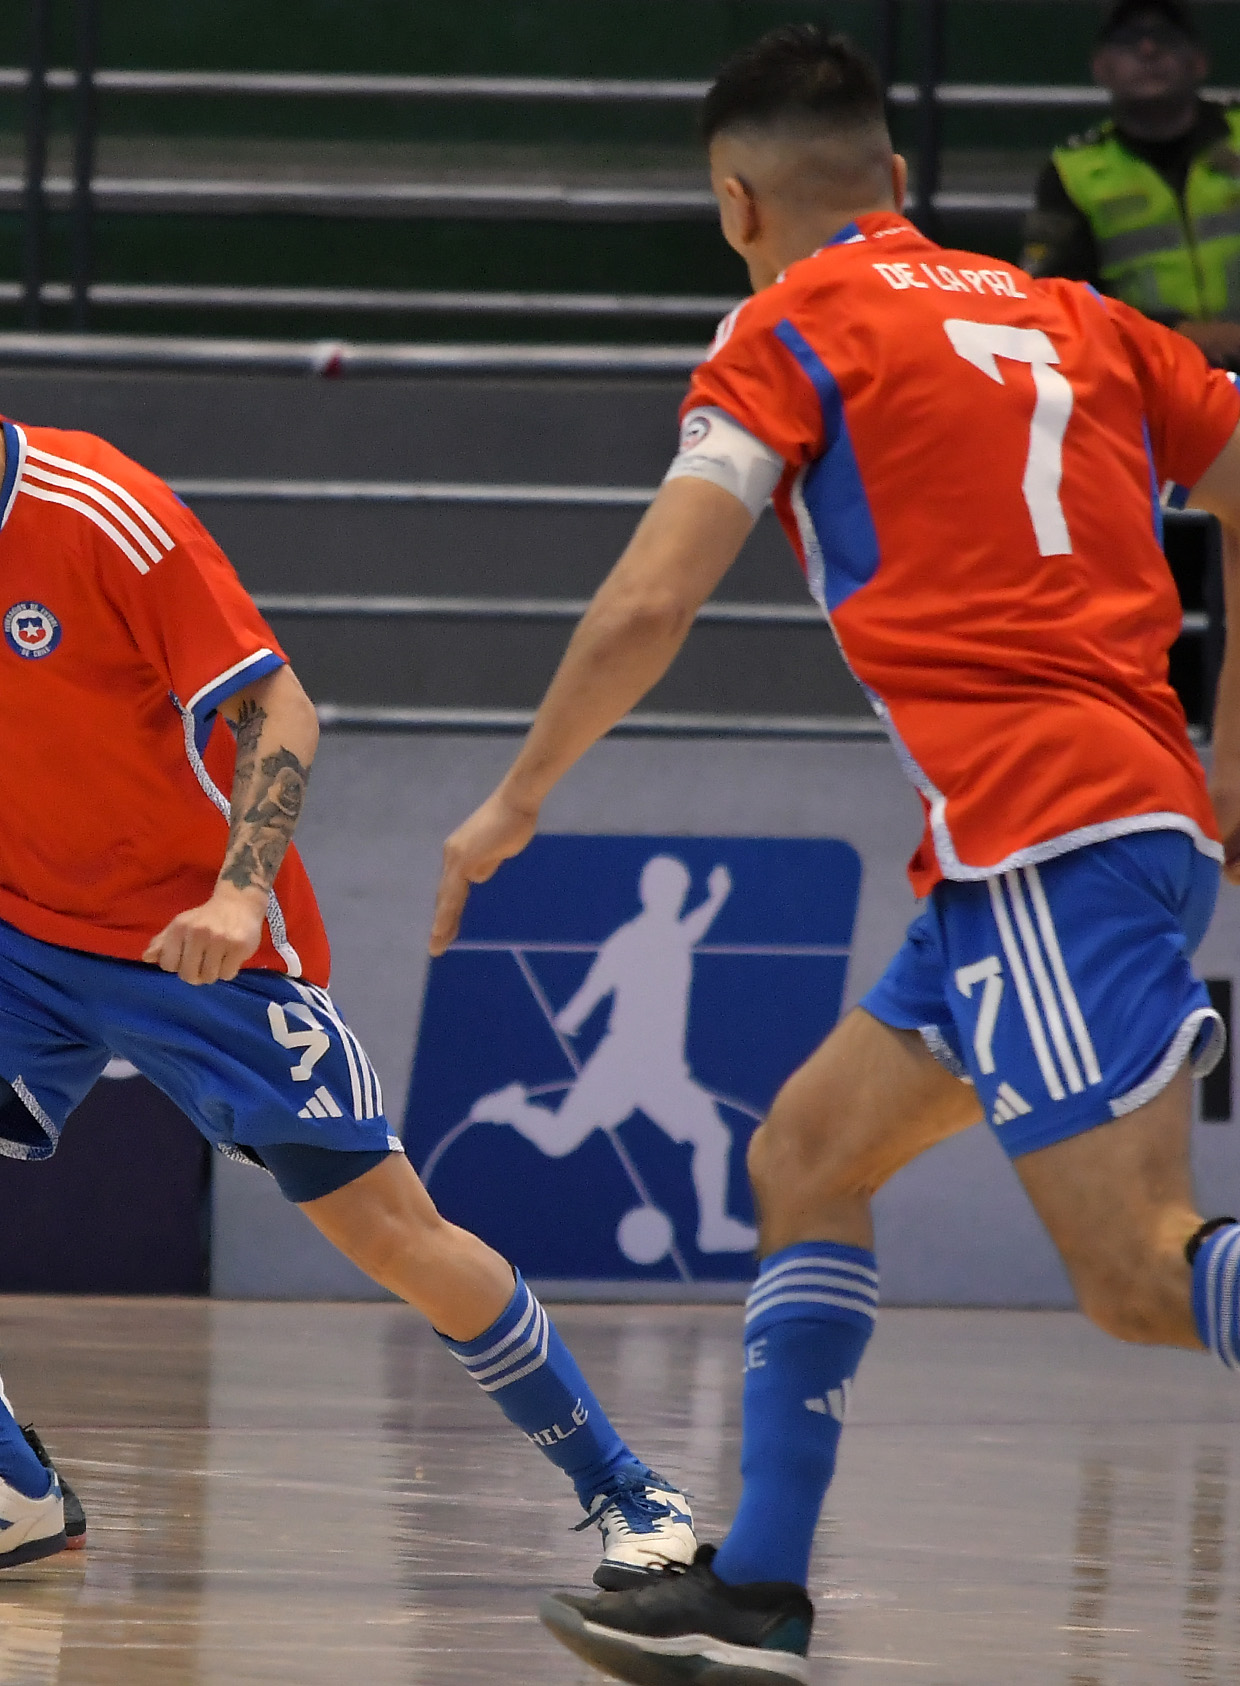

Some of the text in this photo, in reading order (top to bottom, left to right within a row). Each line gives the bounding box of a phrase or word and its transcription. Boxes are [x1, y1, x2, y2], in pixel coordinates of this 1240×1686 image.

[872, 262, 1028, 299] DE LA PAZ
[942, 318, 1074, 557] 7
[266, 1000, 331, 1081] 9
[954, 954, 1005, 1076] 7
